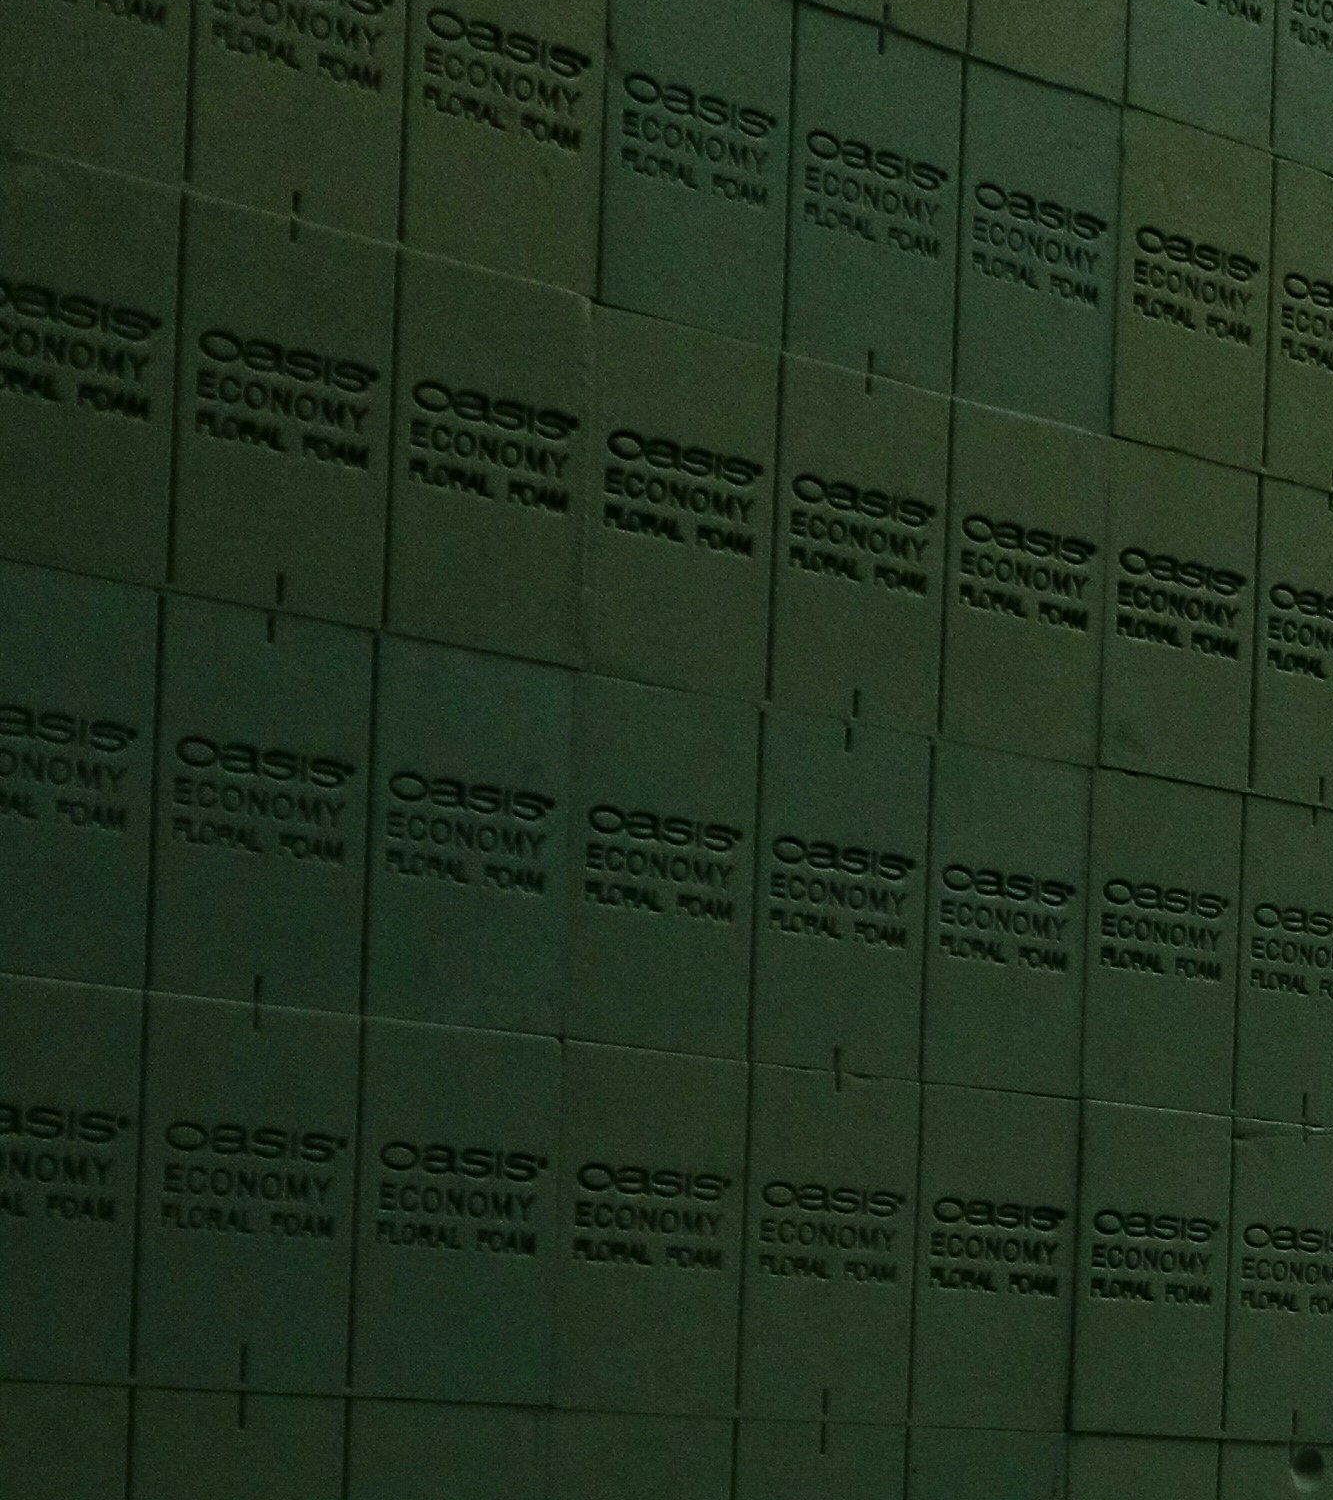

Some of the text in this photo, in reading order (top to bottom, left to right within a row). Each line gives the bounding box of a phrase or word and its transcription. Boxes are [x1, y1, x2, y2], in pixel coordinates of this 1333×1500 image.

[624, 110, 770, 174] ECONOMY
[620, 146, 771, 209] FLORAL FOAM
[413, 420, 568, 477] ECONOMY
[408, 457, 569, 513] FLORAL FOAM
[962, 550, 1088, 598] ECONOMY
[959, 583, 1089, 630] FLORAL FOAM
[176, 777, 346, 827] ECONOMY
[171, 816, 347, 864] FLORAL FOAM
[1103, 913, 1223, 951] ECONOMY
[1100, 945, 1224, 981] FLORAL FOAM
[380, 1182, 537, 1220] ECONOMY
[376, 1221, 538, 1255] FLORAL FOAM
